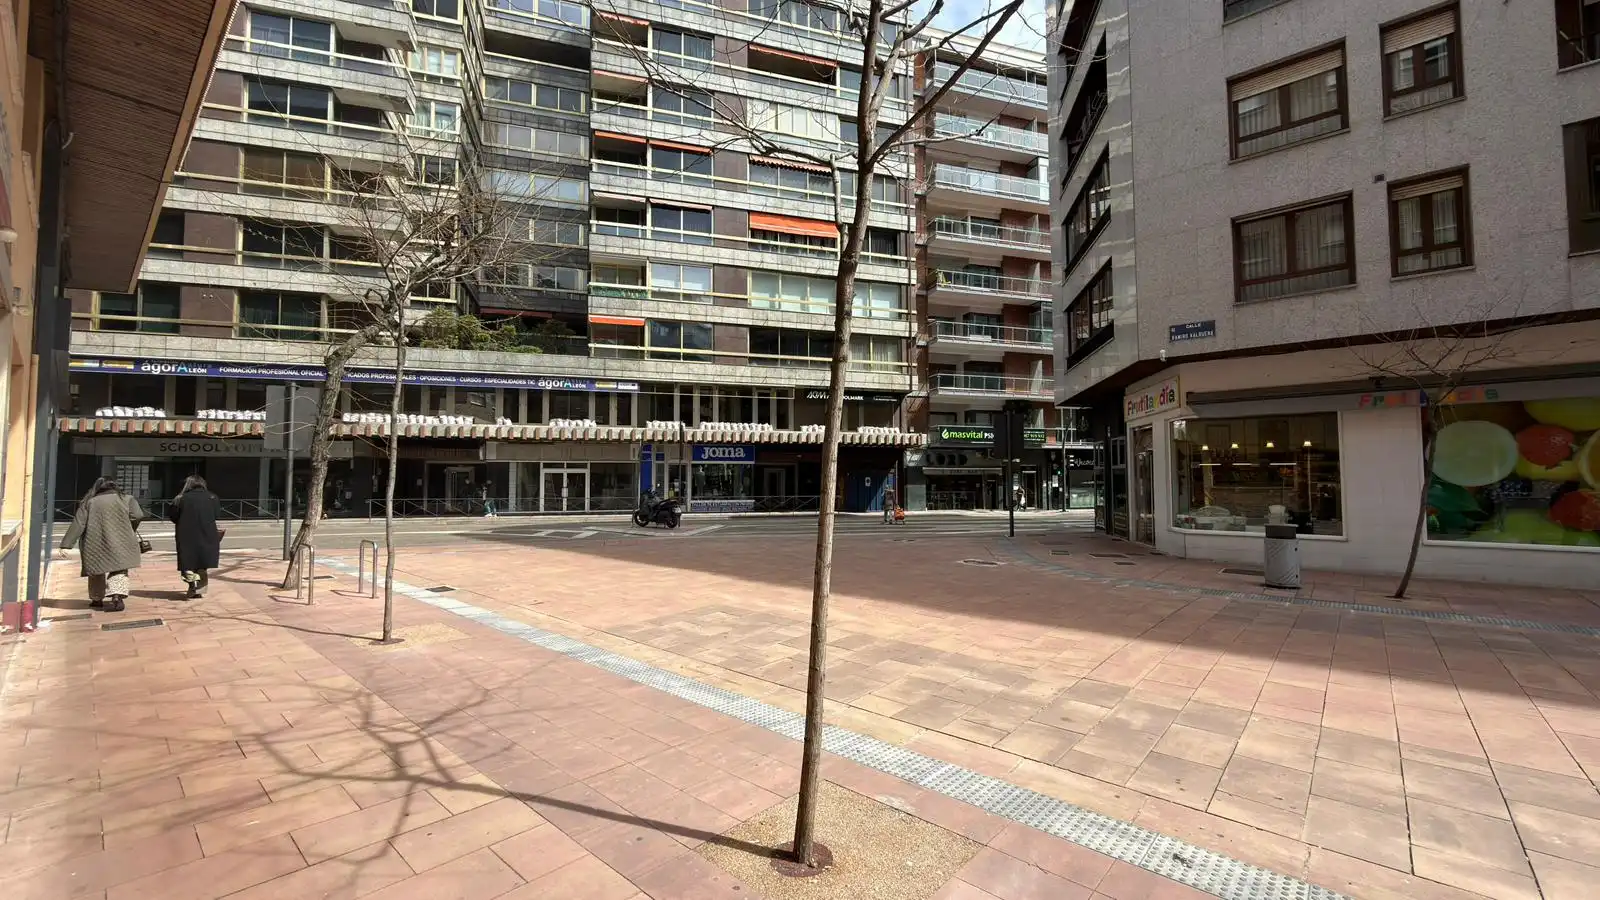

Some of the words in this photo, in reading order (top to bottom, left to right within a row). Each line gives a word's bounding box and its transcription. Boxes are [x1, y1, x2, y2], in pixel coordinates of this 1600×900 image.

[258, 367, 300, 376] PROFESIONAL
[300, 369, 324, 377] OFICIAL
[949, 431, 983, 439] masvital
[159, 442, 221, 453] SCHOOL
